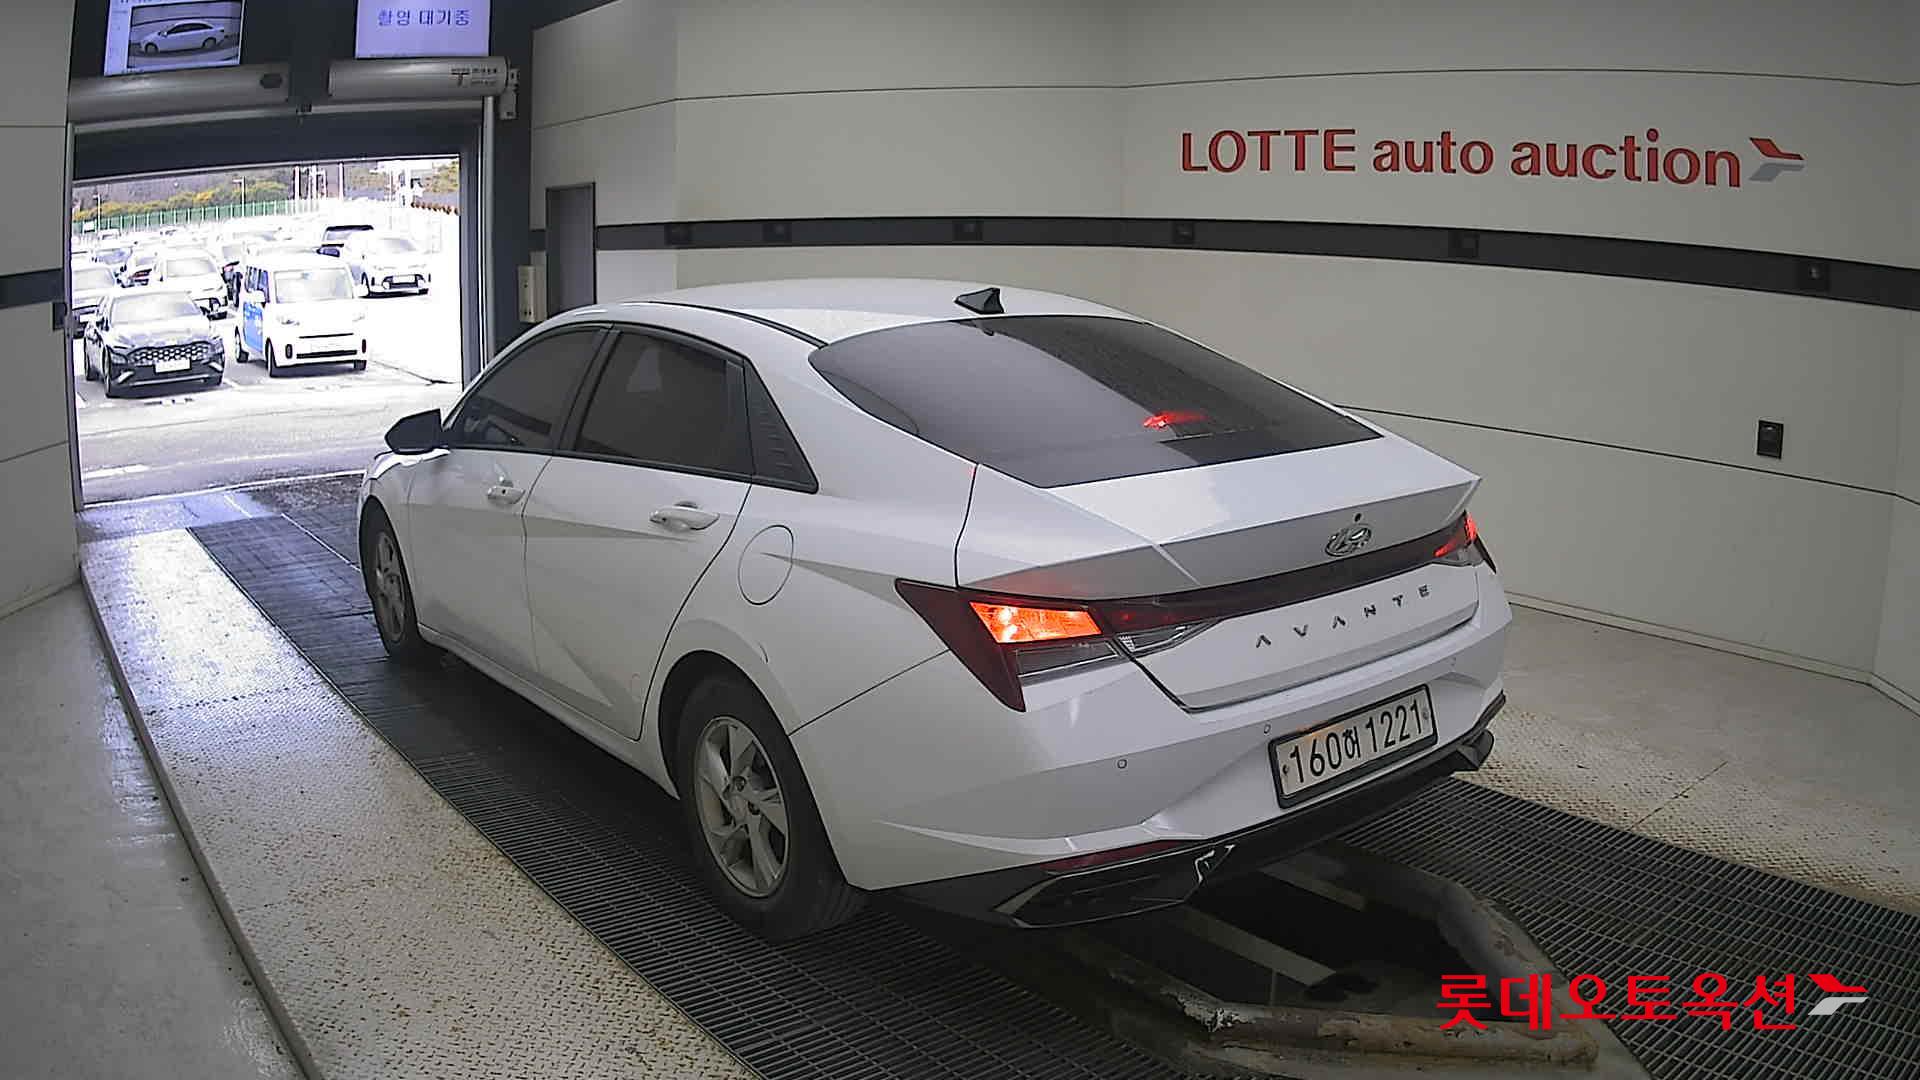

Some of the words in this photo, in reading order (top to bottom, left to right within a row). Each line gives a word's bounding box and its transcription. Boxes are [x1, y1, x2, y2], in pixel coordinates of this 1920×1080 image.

[418, 8, 470, 26] 대기중
[1182, 128, 1356, 172] LOTTE
[1372, 130, 1494, 174] auto
[1510, 127, 1741, 188] auction
[1256, 583, 1430, 649] AVANTE
